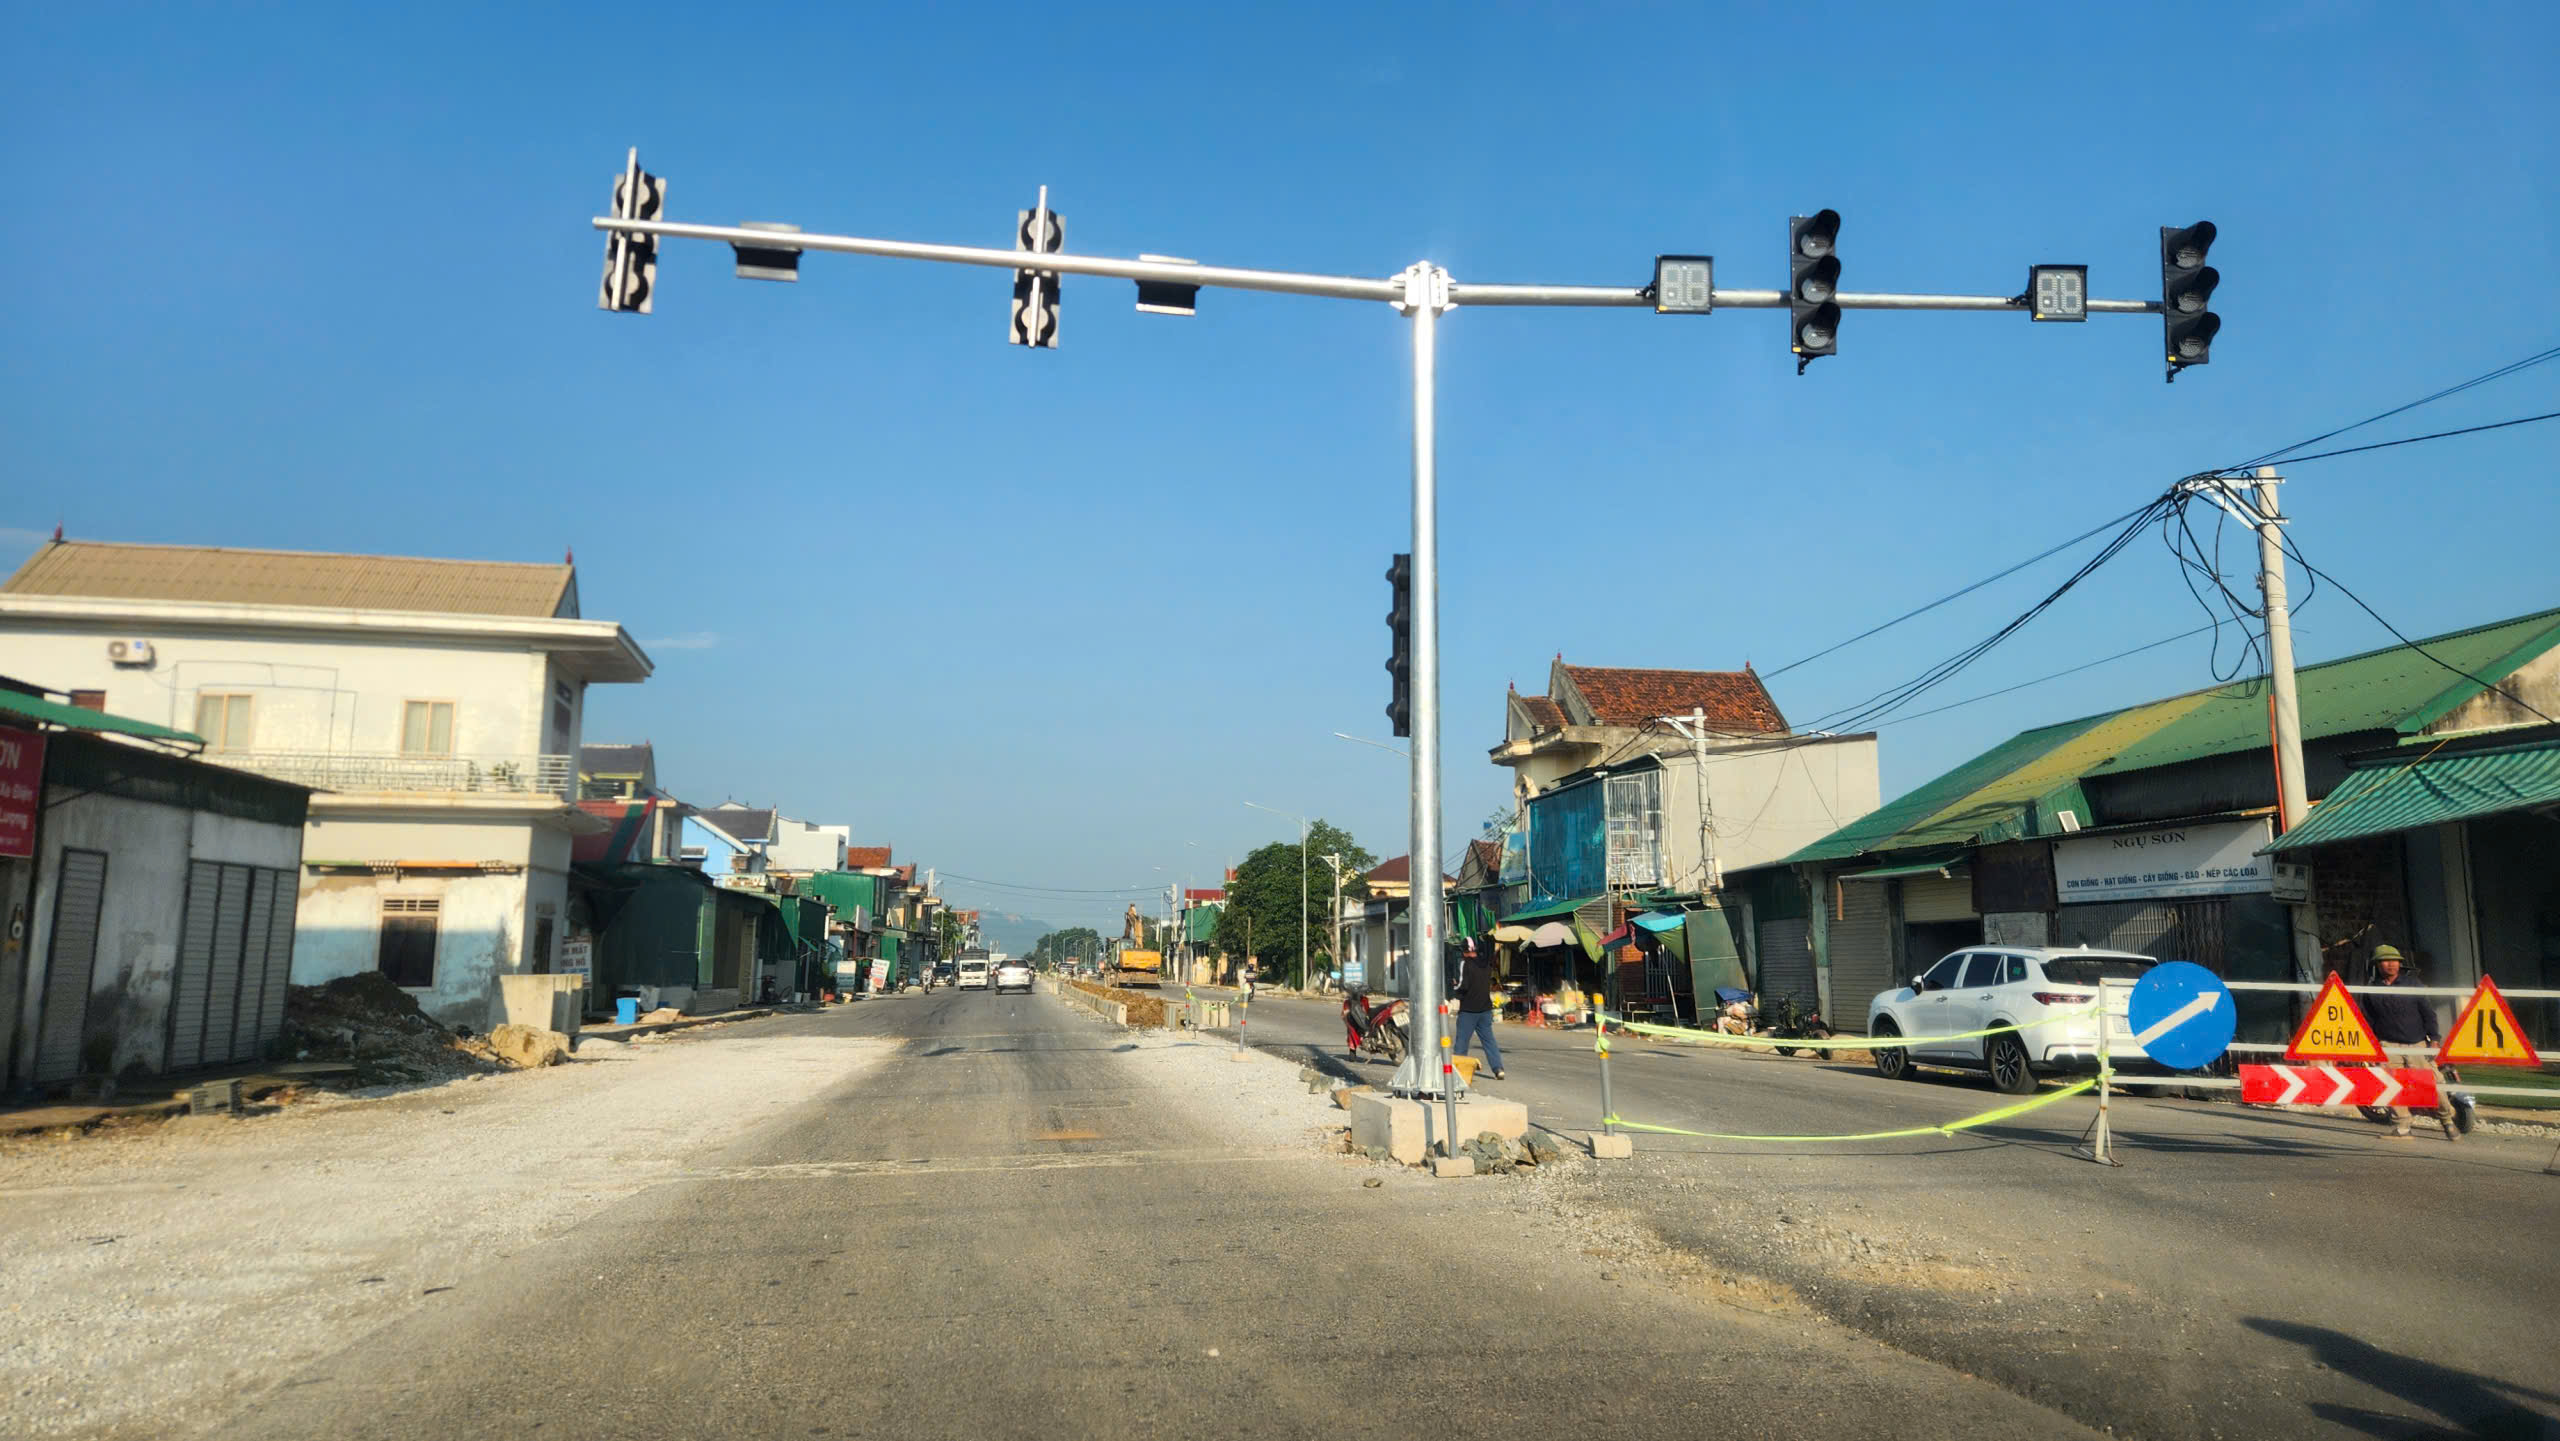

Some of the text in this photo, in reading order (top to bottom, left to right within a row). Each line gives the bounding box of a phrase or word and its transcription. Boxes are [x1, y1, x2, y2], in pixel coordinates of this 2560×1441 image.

[2113, 836, 2146, 849] NGỤ
[2067, 879, 2080, 888] CON
[2240, 867, 2258, 878] LOẠI
[2328, 1005, 2344, 1022] ĐI
[2311, 1025, 2360, 1049] CHẬM
